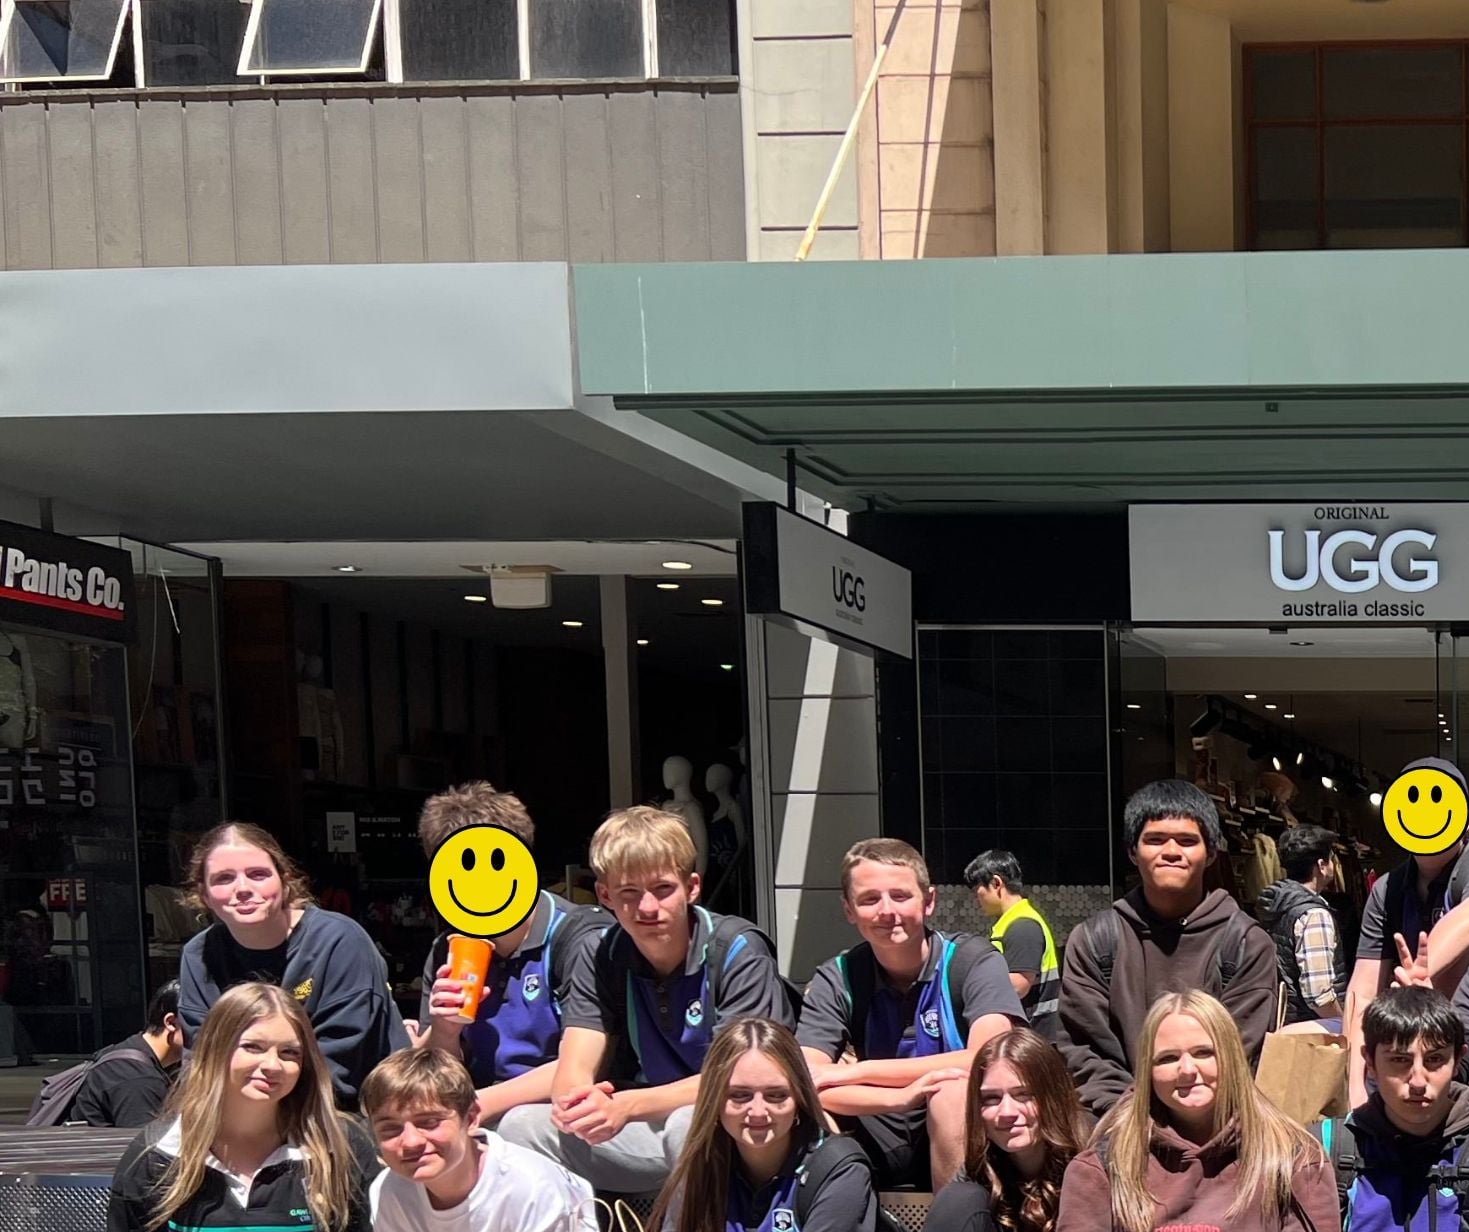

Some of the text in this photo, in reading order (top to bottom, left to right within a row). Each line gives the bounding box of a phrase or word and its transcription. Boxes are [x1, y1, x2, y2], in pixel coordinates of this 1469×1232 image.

[1313, 507, 1390, 520] ORIGINAL
[4, 547, 125, 611] Pants Co.
[1267, 528, 1439, 593] UGG
[832, 566, 866, 612] UGG
[1282, 600, 1425, 617] australia classic
